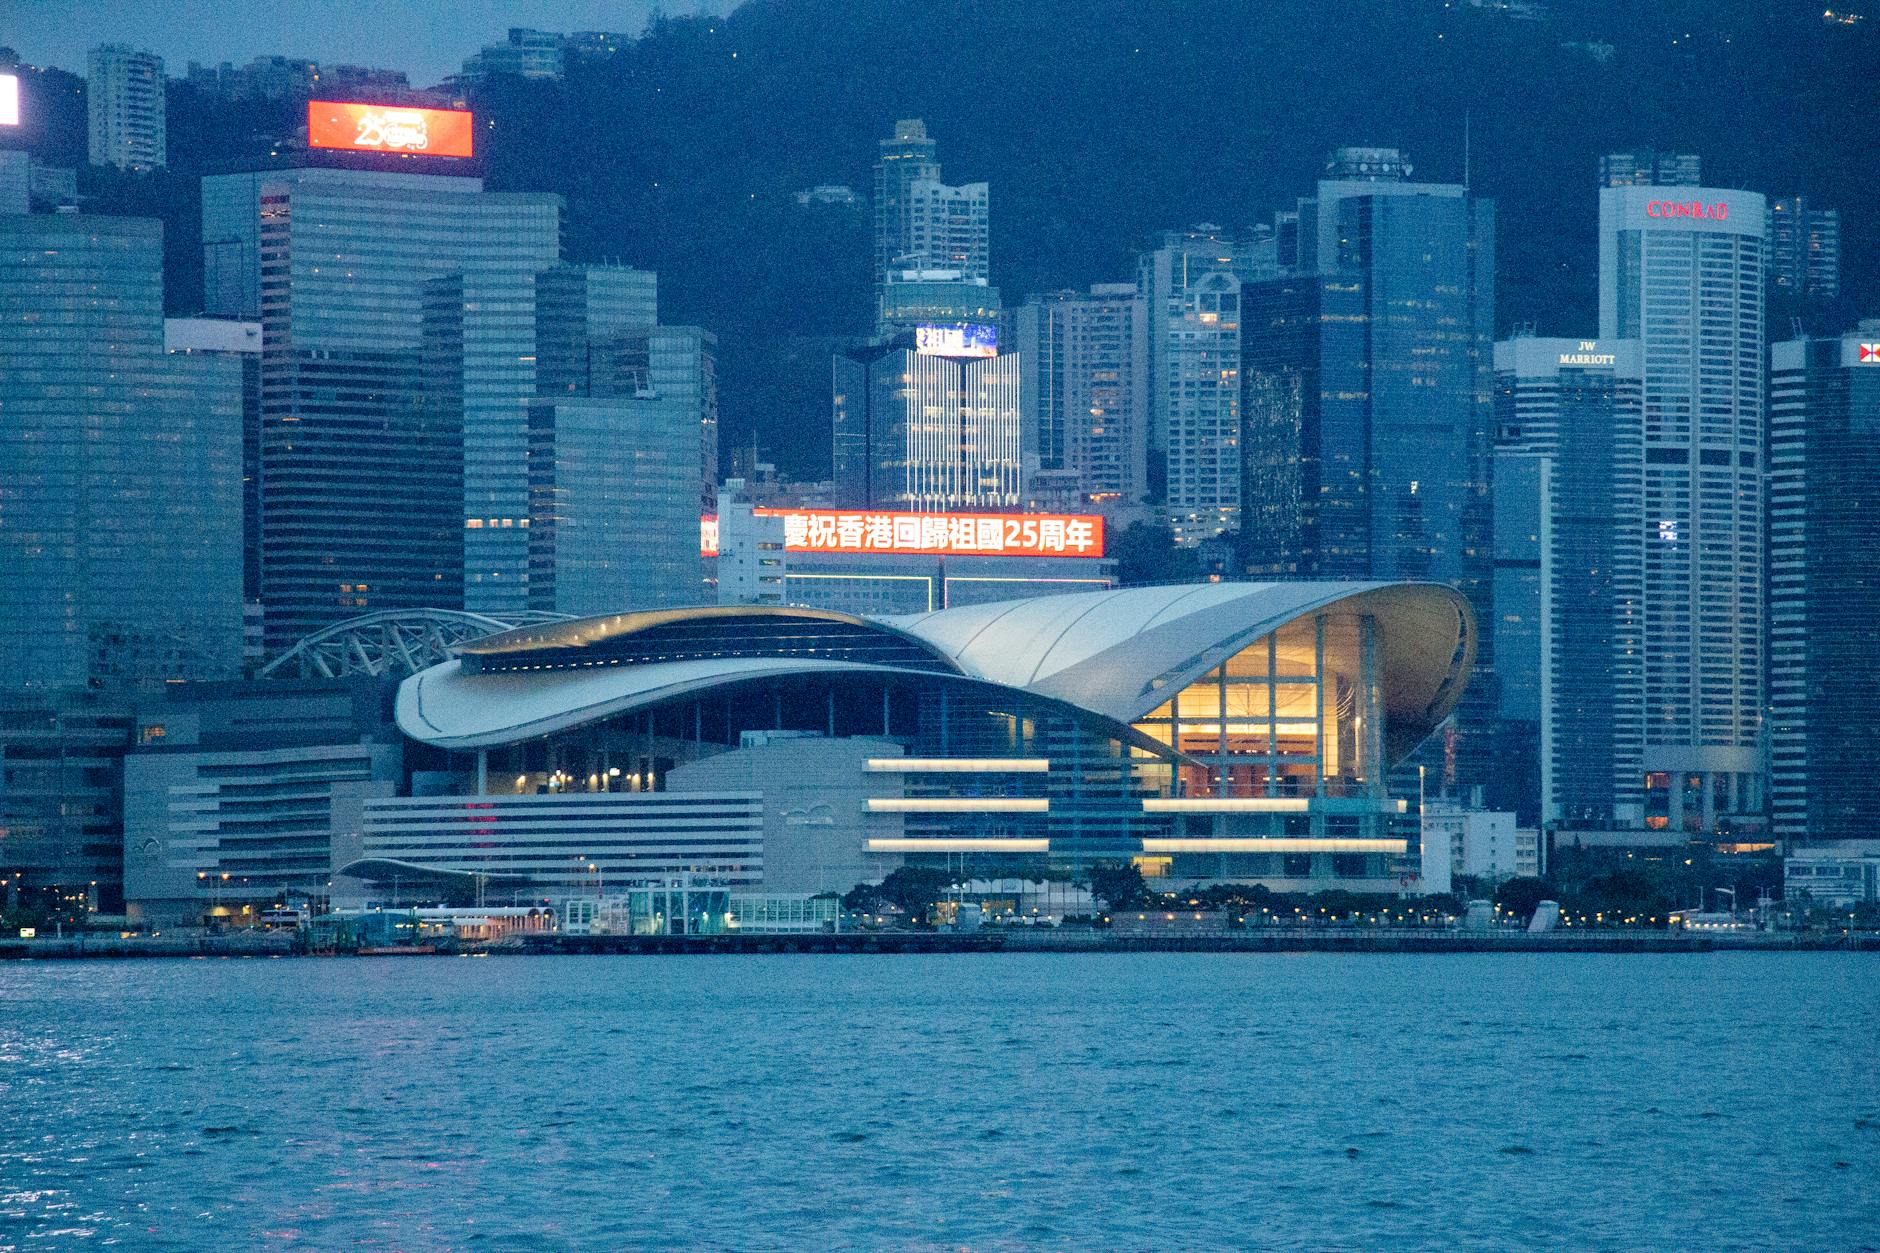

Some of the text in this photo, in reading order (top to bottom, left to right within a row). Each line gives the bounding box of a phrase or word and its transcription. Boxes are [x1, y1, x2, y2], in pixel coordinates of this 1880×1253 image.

[1647, 200, 1728, 220] CONRAD
[1578, 341, 1596, 351] JW
[1559, 354, 1616, 365] MARRIOTT
[753, 512, 1094, 552] 慶祝香港回歸祖國25周年
